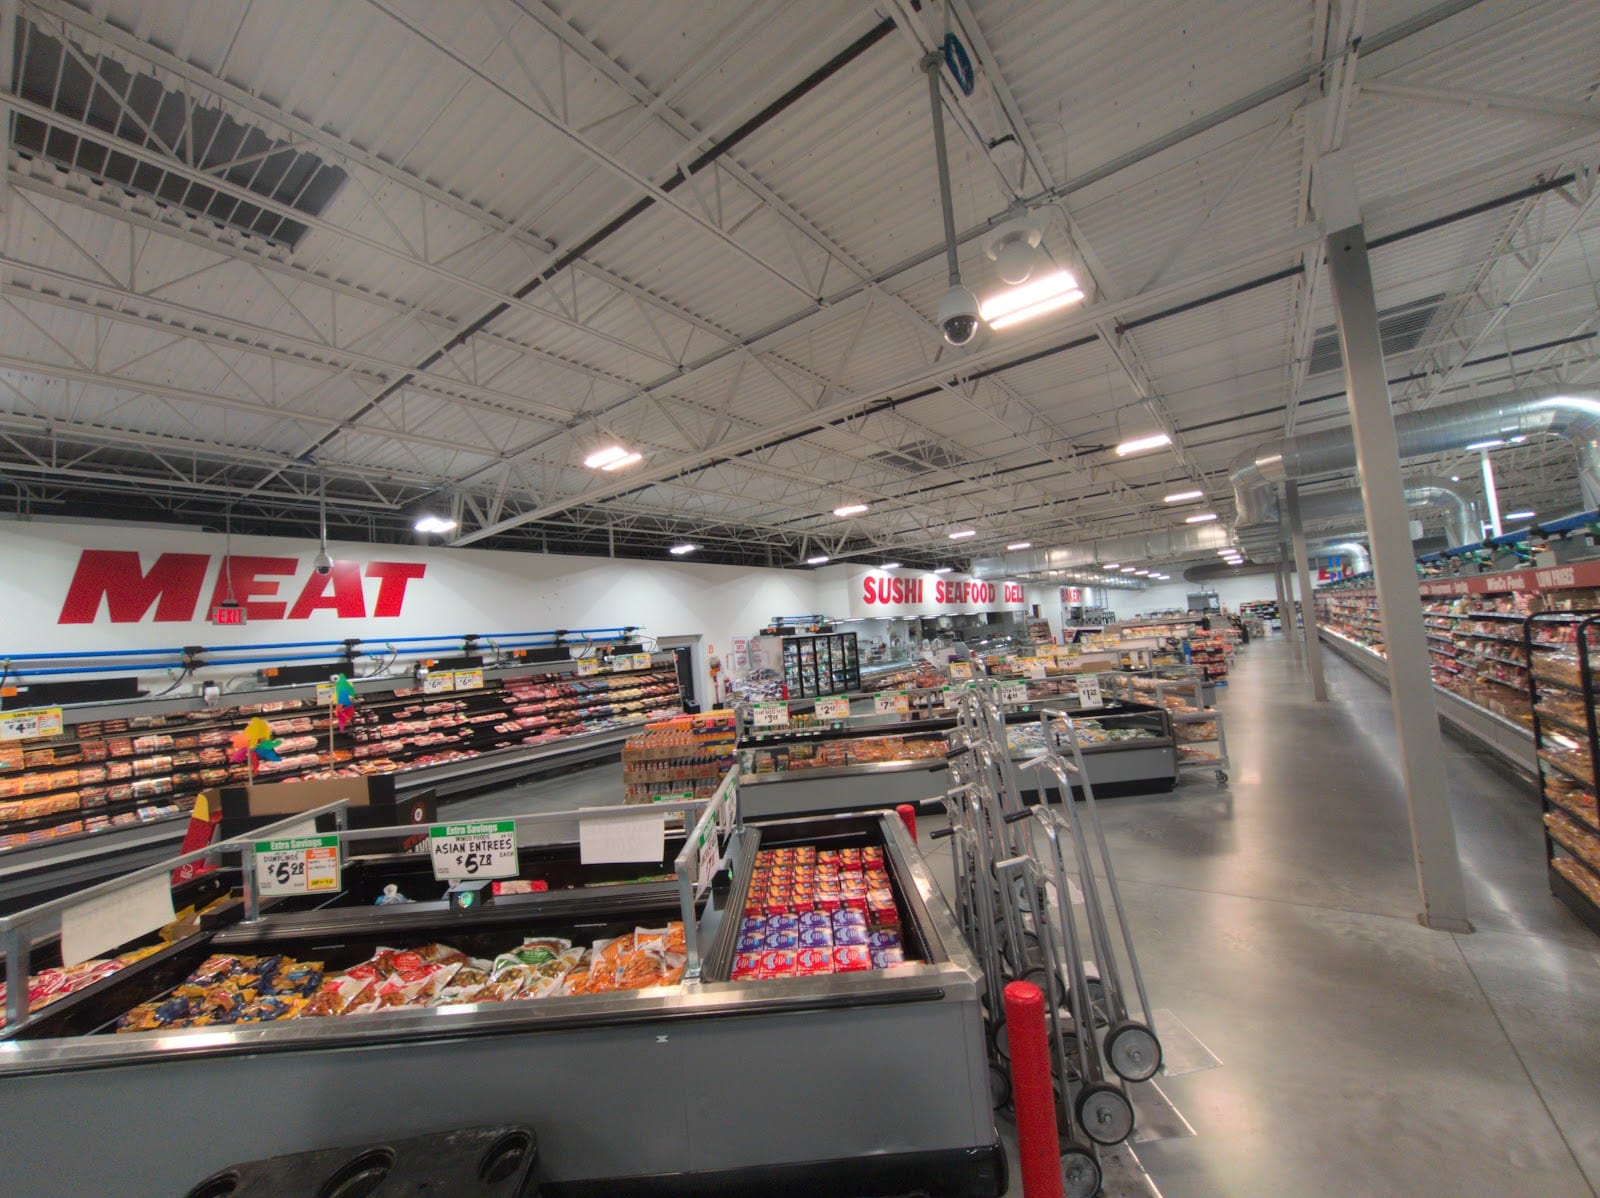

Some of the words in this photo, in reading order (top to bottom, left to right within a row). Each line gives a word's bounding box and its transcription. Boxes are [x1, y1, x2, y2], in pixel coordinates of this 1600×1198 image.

[57, 549, 427, 624] MEAT
[863, 576, 923, 605] SUSHI
[935, 580, 996, 604] SEAFOOD
[1004, 584, 1024, 603] DELI
[218, 608, 242, 624] EXIT
[446, 826, 466, 836] Extra
[466, 823, 499, 835] Savings
[270, 841, 290, 851] Extra
[290, 838, 322, 849] Savings
[435, 843, 466, 855] ASIAN
[469, 839, 513, 853] ENTREES
